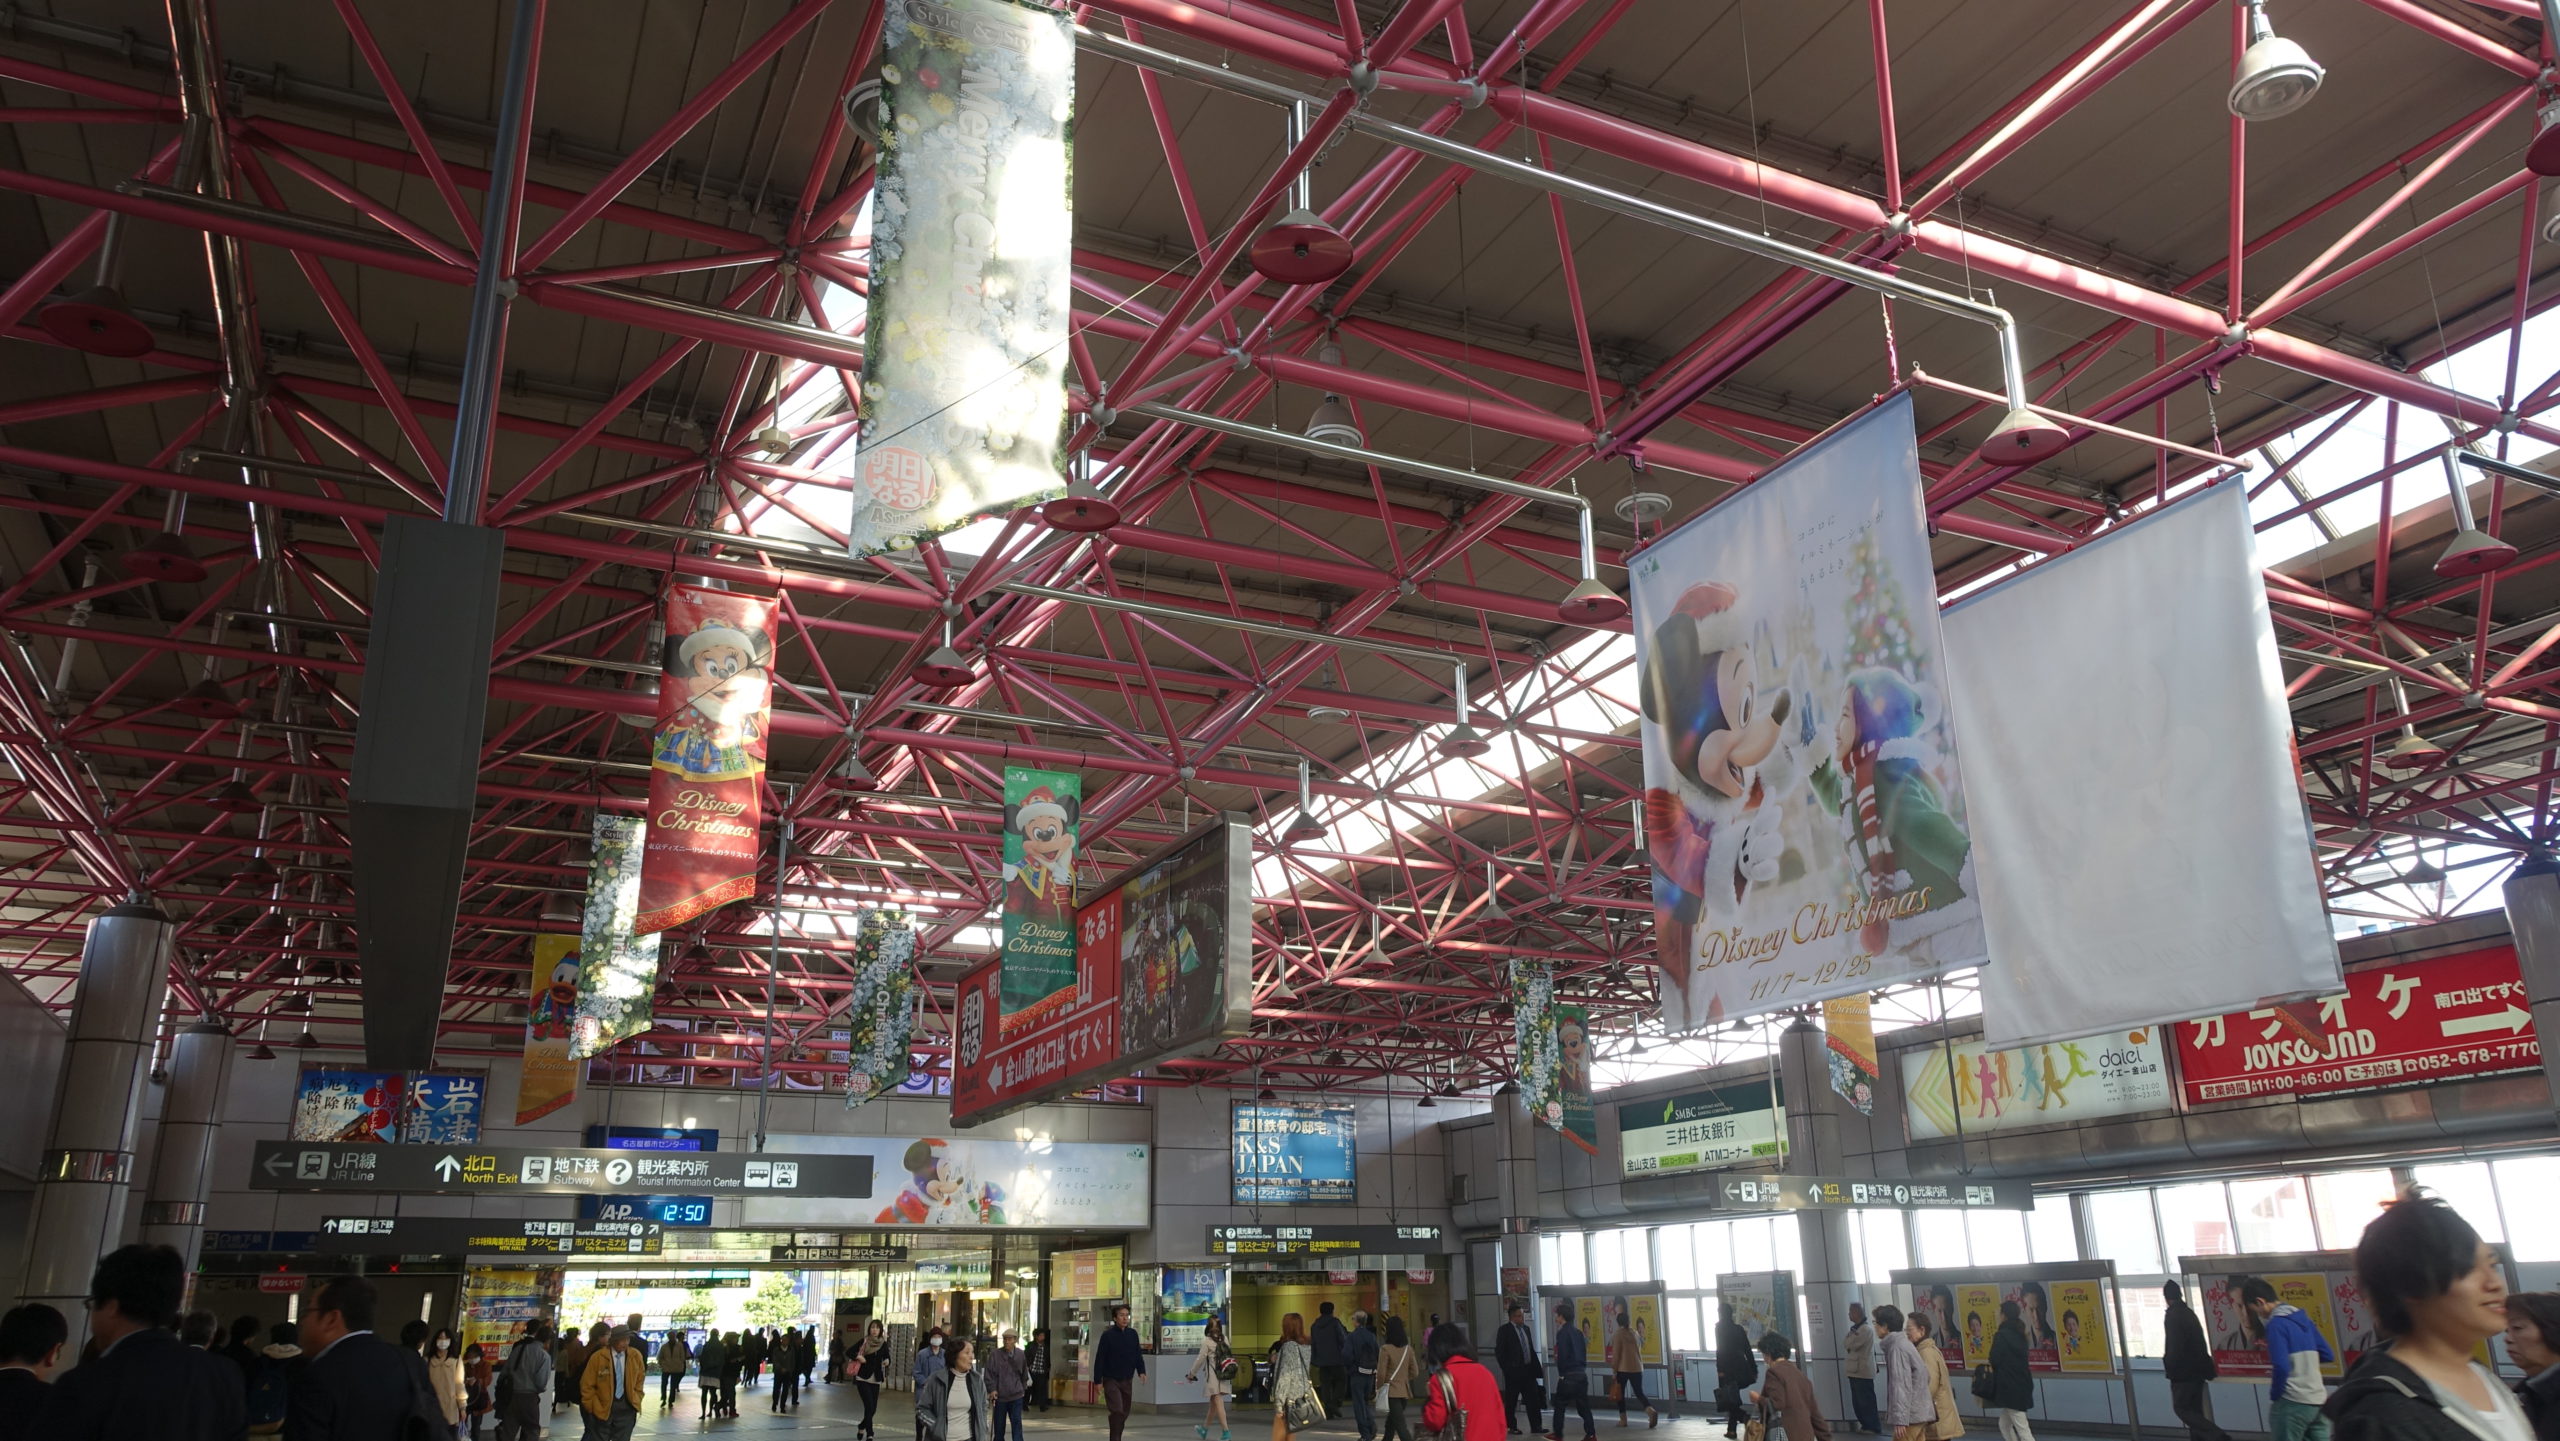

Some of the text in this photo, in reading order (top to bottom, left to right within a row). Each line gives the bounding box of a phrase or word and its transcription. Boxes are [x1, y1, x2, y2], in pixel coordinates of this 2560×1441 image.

[916, 5, 960, 28] Style
[946, 68, 1001, 203] Merry
[674, 790, 748, 818] Disney
[657, 809, 754, 838] Christmas
[1790, 885, 1933, 945] Christmas
[1018, 922, 1068, 942] Disney
[1008, 937, 1074, 957] Christmas
[1697, 927, 1788, 971] Disney
[873, 938, 892, 1071] Merry Christmas
[2244, 1029, 2377, 1072] JOYSOUND
[2419, 1042, 2541, 1071] 052-678-7770
[2101, 1064, 2157, 1079] ダイエー金山店
[2347, 1062, 2398, 1080] ご予約は
[2204, 1080, 2247, 1098] 営業時間
[1675, 1107, 1697, 1121] SMBC
[1666, 1120, 1736, 1147] 三井住友銀行
[622, 1140, 685, 1149] 名古屋都市センター
[1239, 1135, 1281, 1155] K&S
[333, 1152, 377, 1170] JR線
[1704, 1145, 1750, 1163] ATMコーナー
[463, 1155, 496, 1172] 北口
[553, 1157, 599, 1175] 地下鉄
[637, 1159, 709, 1177] 観光案内所
[775, 1163, 796, 1172] TAXI
[1237, 1154, 1304, 1174] JAPAN
[1627, 1157, 1658, 1173] 金山支店
[331, 1171, 375, 1182] JR Line
[463, 1172, 518, 1185] North Exit
[553, 1174, 595, 1188] Subway
[637, 1176, 741, 1188] Tourist Information Center
[1759, 1181, 1781, 1195] JR線
[1823, 1184, 1839, 1195] 北口
[1868, 1184, 1892, 1196] 地下鉄
[1910, 1185, 1948, 1198] 観光案内所
[1868, 1196, 1892, 1206] Subway
[663, 1205, 705, 1221] 12:50
[370, 1220, 395, 1229] 地下鉄
[524, 1222, 546, 1231] 地下鉄
[595, 1223, 630, 1232] 観光案内所
[531, 1238, 559, 1247] タクシー
[575, 1238, 628, 1247] 市バスターミナル
[1237, 1241, 1277, 1249] 市バスターミナル
[852, 1248, 896, 1257] 市バスターミナル
